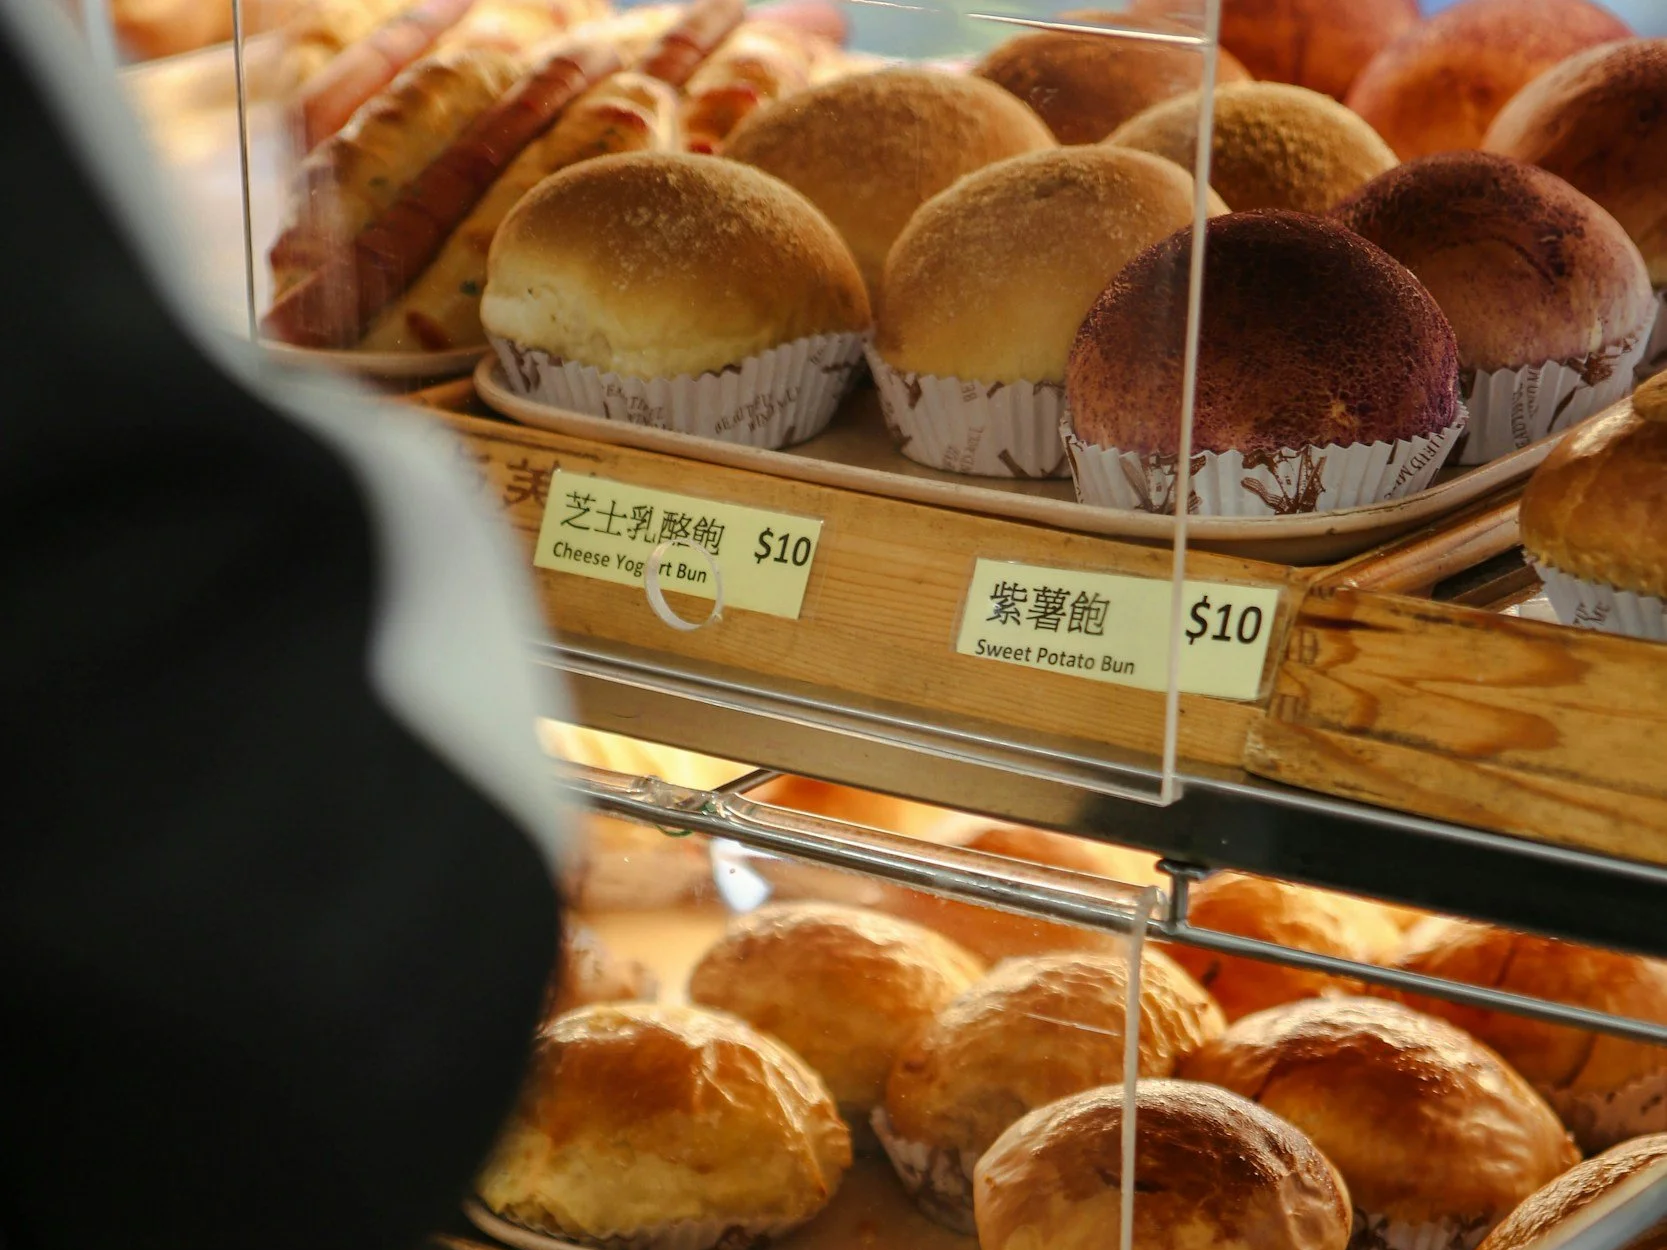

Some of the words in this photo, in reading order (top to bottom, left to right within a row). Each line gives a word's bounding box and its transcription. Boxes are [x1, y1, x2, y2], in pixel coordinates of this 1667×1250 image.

[560, 490, 726, 556] 芝士乳酪飽
[754, 527, 812, 566] $10
[553, 541, 610, 567] Cheese
[616, 554, 671, 577] Yogrt
[676, 563, 707, 583] Bun
[985, 581, 1110, 636] 紫薯飽
[1185, 595, 1263, 645] $10
[975, 639, 1031, 663] Sweet
[1036, 647, 1095, 671] Potato
[1101, 655, 1135, 675] Bun
